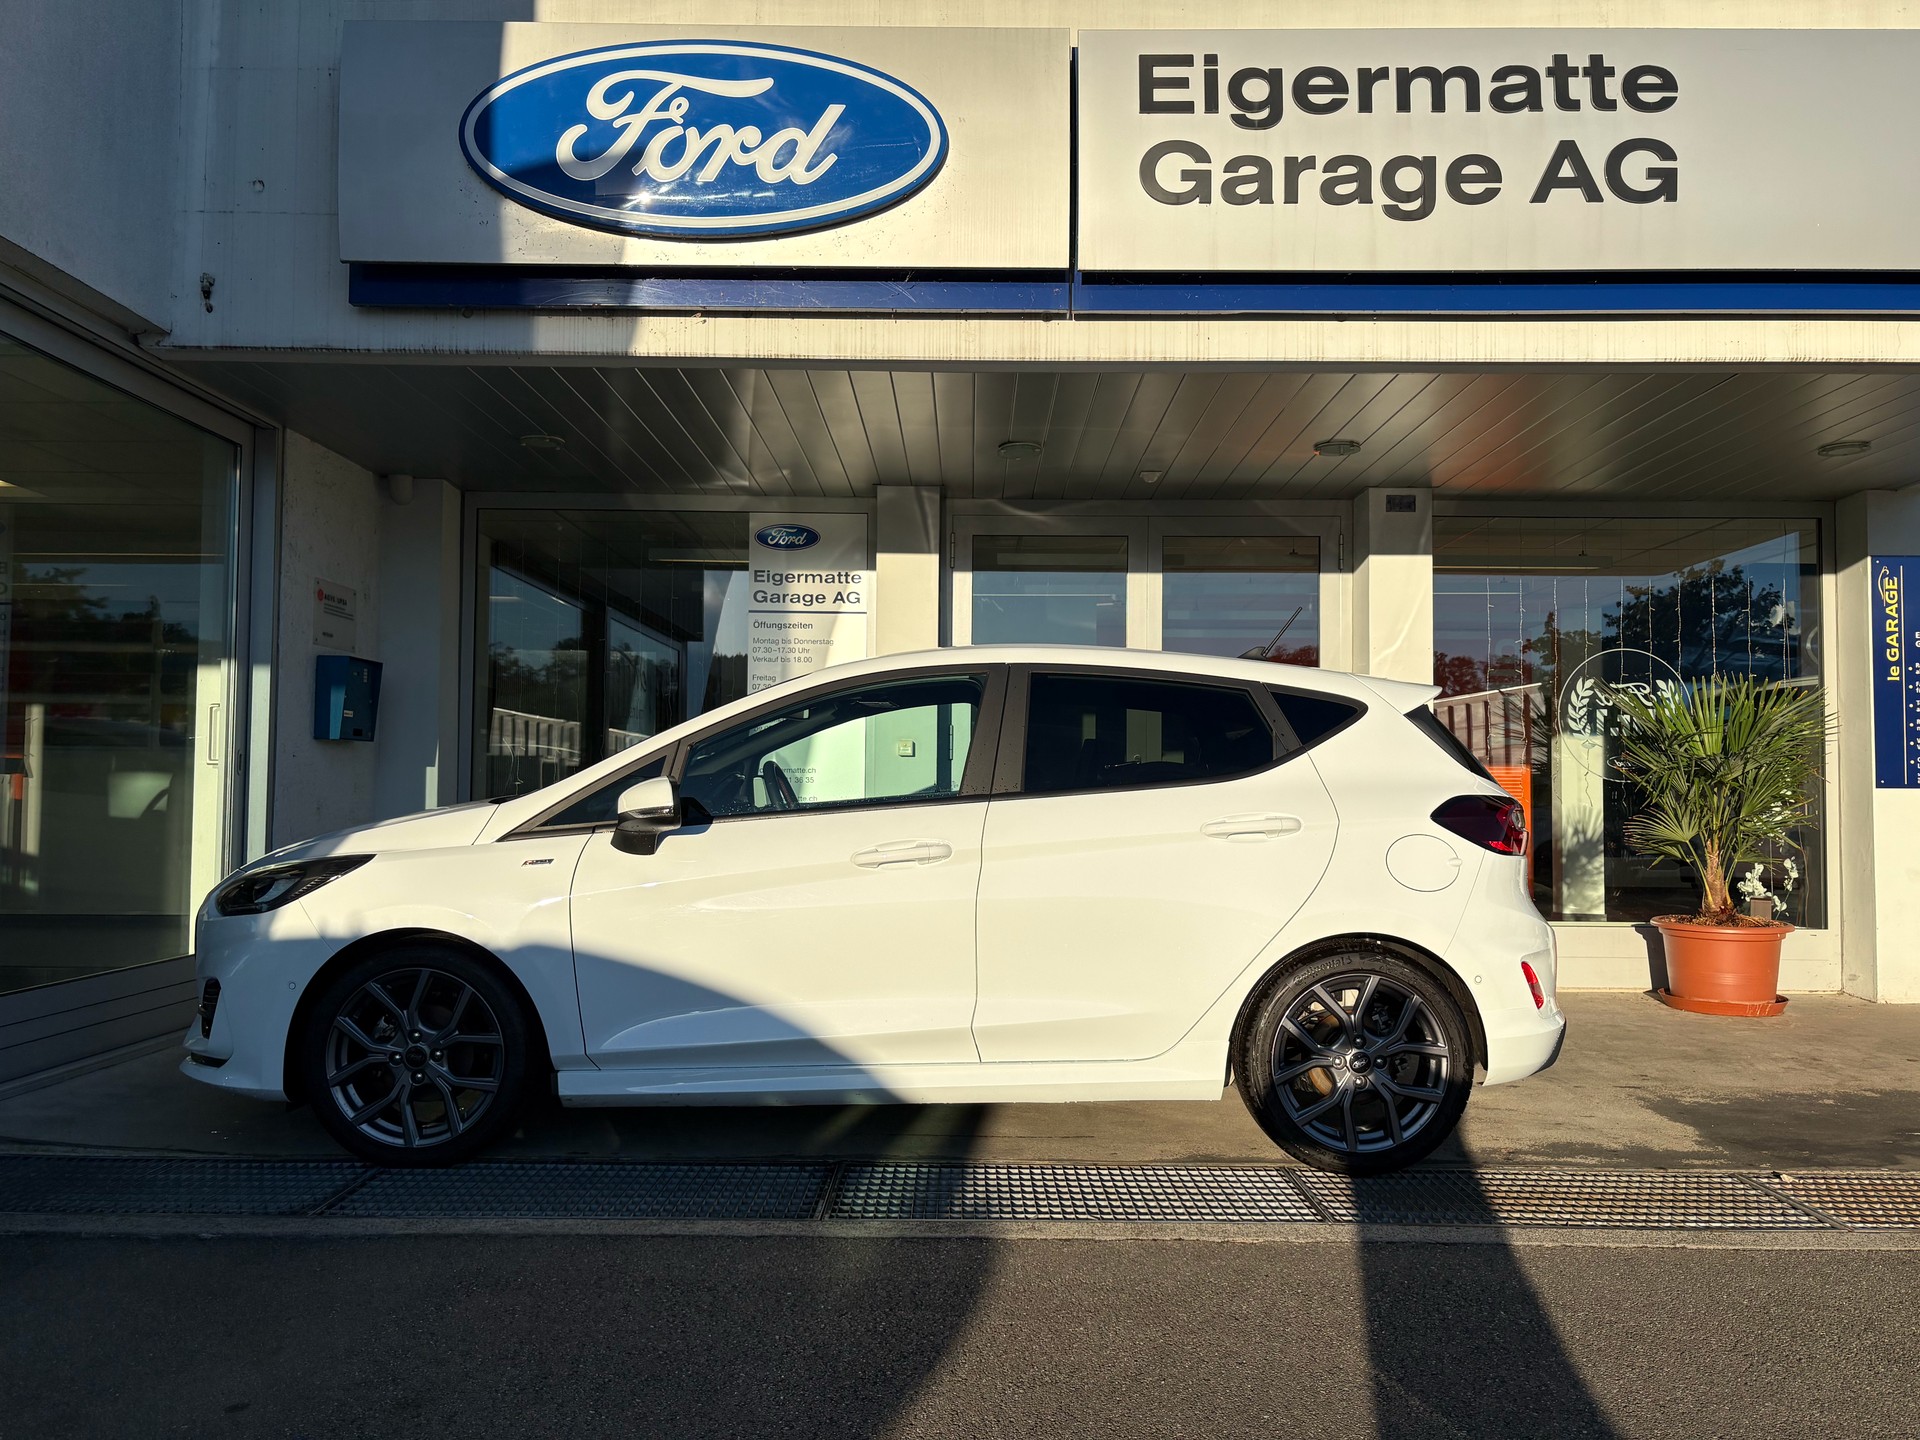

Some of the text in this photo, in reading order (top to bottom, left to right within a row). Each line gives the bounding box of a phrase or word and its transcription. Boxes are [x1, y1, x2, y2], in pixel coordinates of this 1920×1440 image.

[1138, 53, 1679, 131] Eigermatte
[556, 70, 847, 185] Ford
[1138, 137, 1679, 222] Garage AG
[767, 527, 807, 545] Ford
[753, 569, 862, 586] Eigermatte
[753, 590, 861, 606] Garage AG
[1885, 576, 1900, 681] le GARAGE
[752, 637, 834, 646] Montag bis Donnerstag
[752, 674, 777, 682] Freitag
